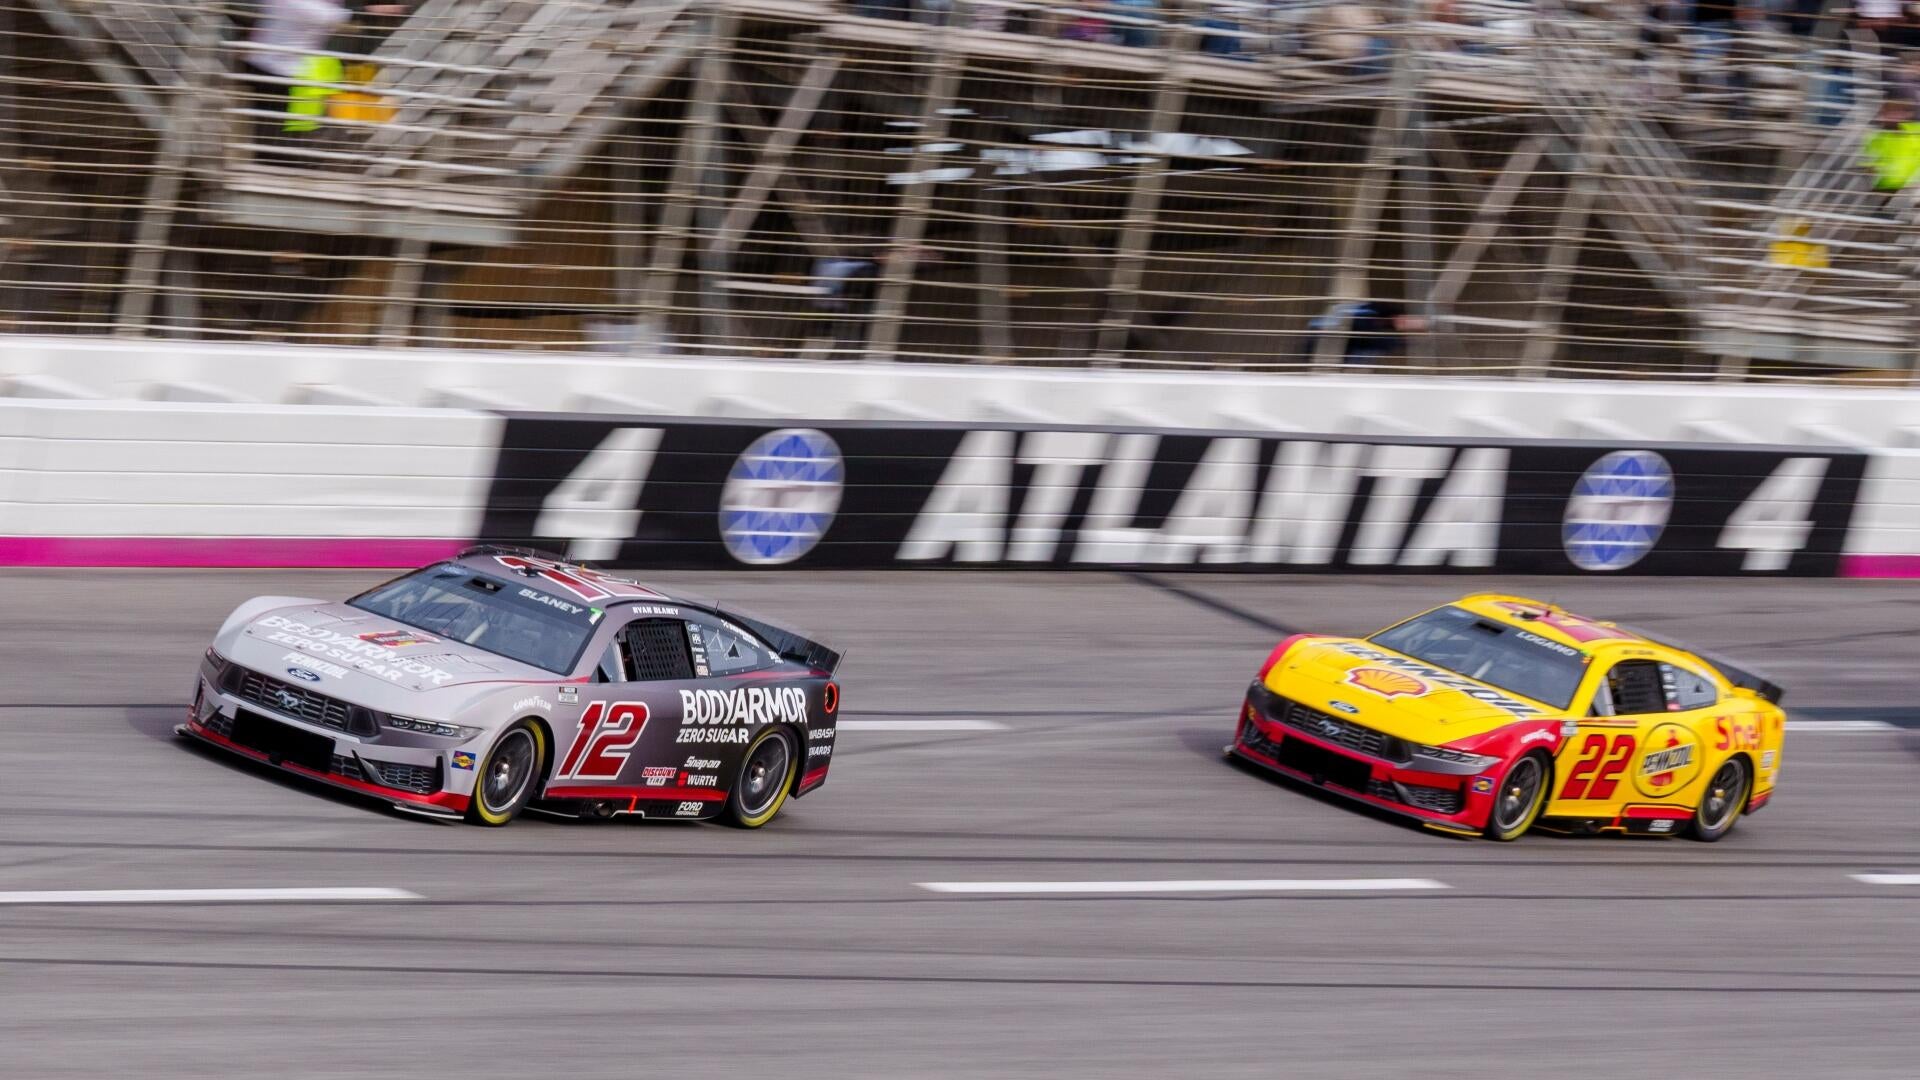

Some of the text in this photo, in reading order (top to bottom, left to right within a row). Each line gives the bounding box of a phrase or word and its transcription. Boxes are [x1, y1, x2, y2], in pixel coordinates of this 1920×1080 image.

[532, 428, 666, 561] 4
[896, 430, 1511, 567] ATLANTA
[1715, 457, 1832, 571] 4
[518, 588, 584, 615] BLANEY
[632, 606, 679, 615] RYAN BLANEY
[257, 615, 454, 686] BODYARMOR
[267, 632, 402, 681] ZERO SUGAR
[1516, 631, 1578, 656] LOGANO
[679, 687, 808, 725] BODYARMOR
[555, 701, 650, 780] 12
[676, 728, 749, 743] ZERO SUGAR
[642, 767, 676, 778] DISCOUNT
[684, 756, 721, 770] Snap-on
[1559, 734, 1636, 799] 22
[687, 775, 717, 786] WÜRTH
[678, 802, 703, 811] FORD
